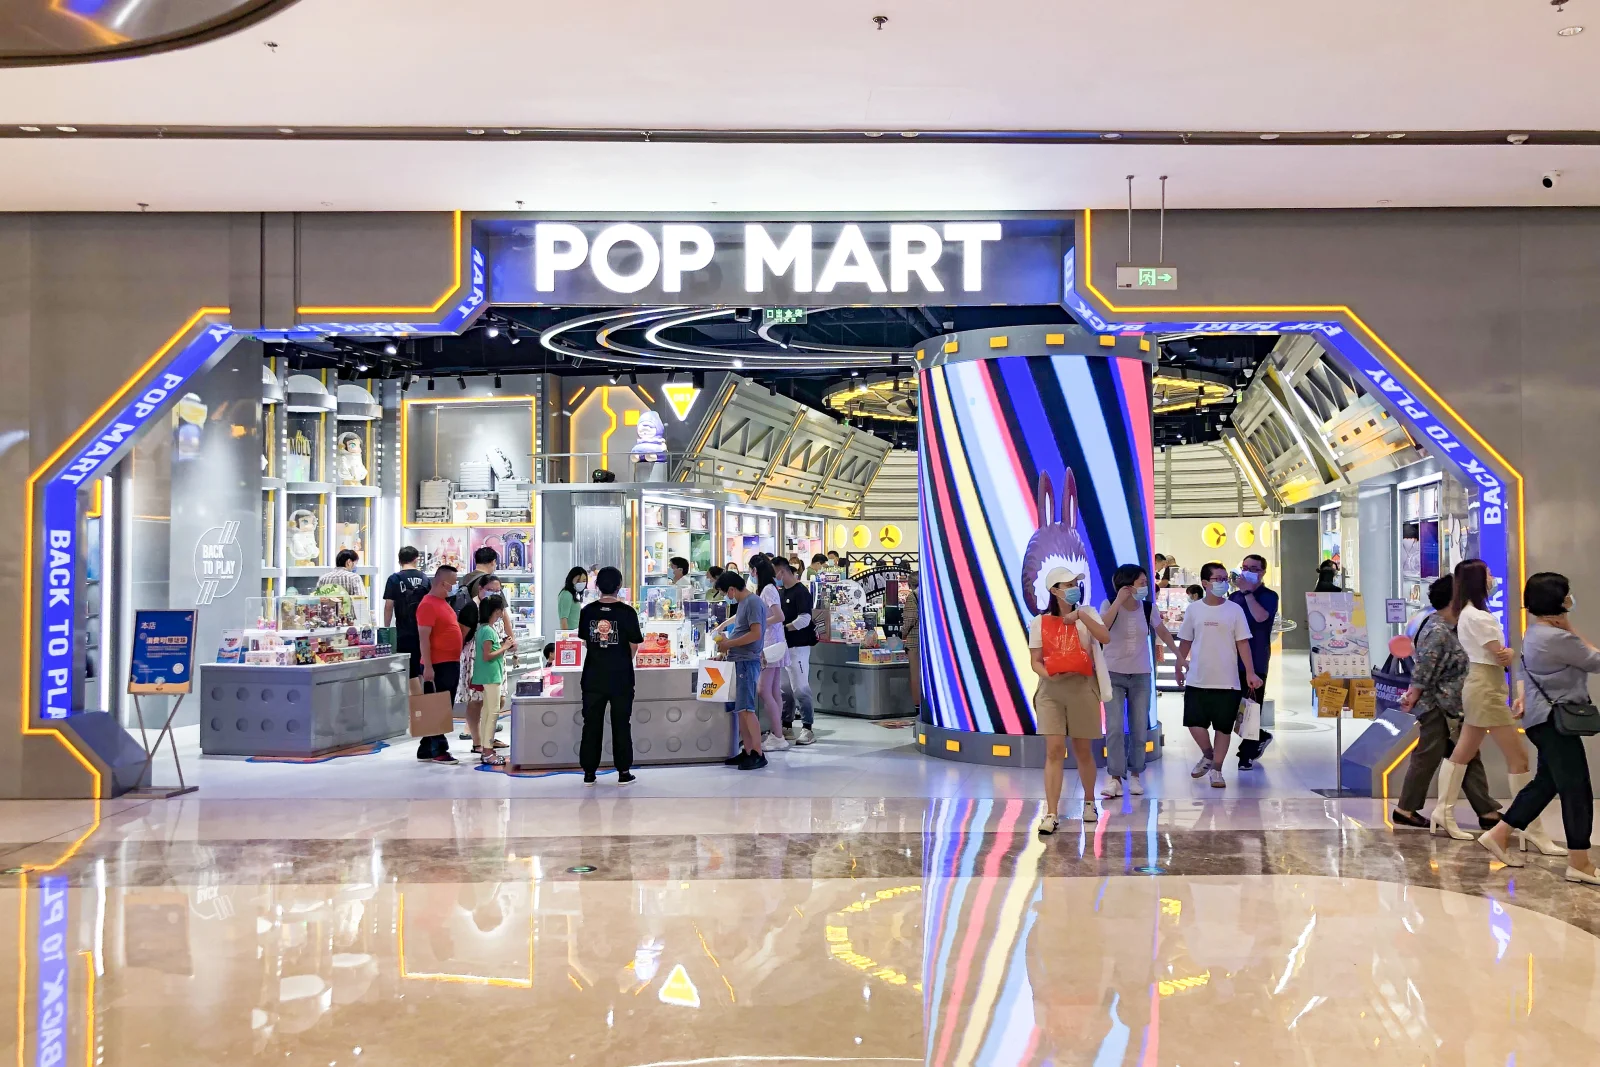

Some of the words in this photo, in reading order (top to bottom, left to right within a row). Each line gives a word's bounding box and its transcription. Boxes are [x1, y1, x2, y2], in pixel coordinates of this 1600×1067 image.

[535, 223, 715, 293] POP
[743, 223, 1002, 293] MART
[1075, 300, 1147, 331] BACK
[1186, 321, 1281, 332] MART
[134, 373, 184, 419] POP
[1365, 368, 1429, 420] PLAY
[60, 422, 135, 485] MART
[1425, 425, 1461, 453] TO
[1459, 458, 1502, 525] BACK
[49, 529, 71, 608] BACK
[202, 544, 224, 559] BACK
[203, 560, 214, 575] TO
[216, 560, 236, 575] PLAY
[48, 618, 69, 657] TO
[1375, 682, 1397, 695] MAKE
